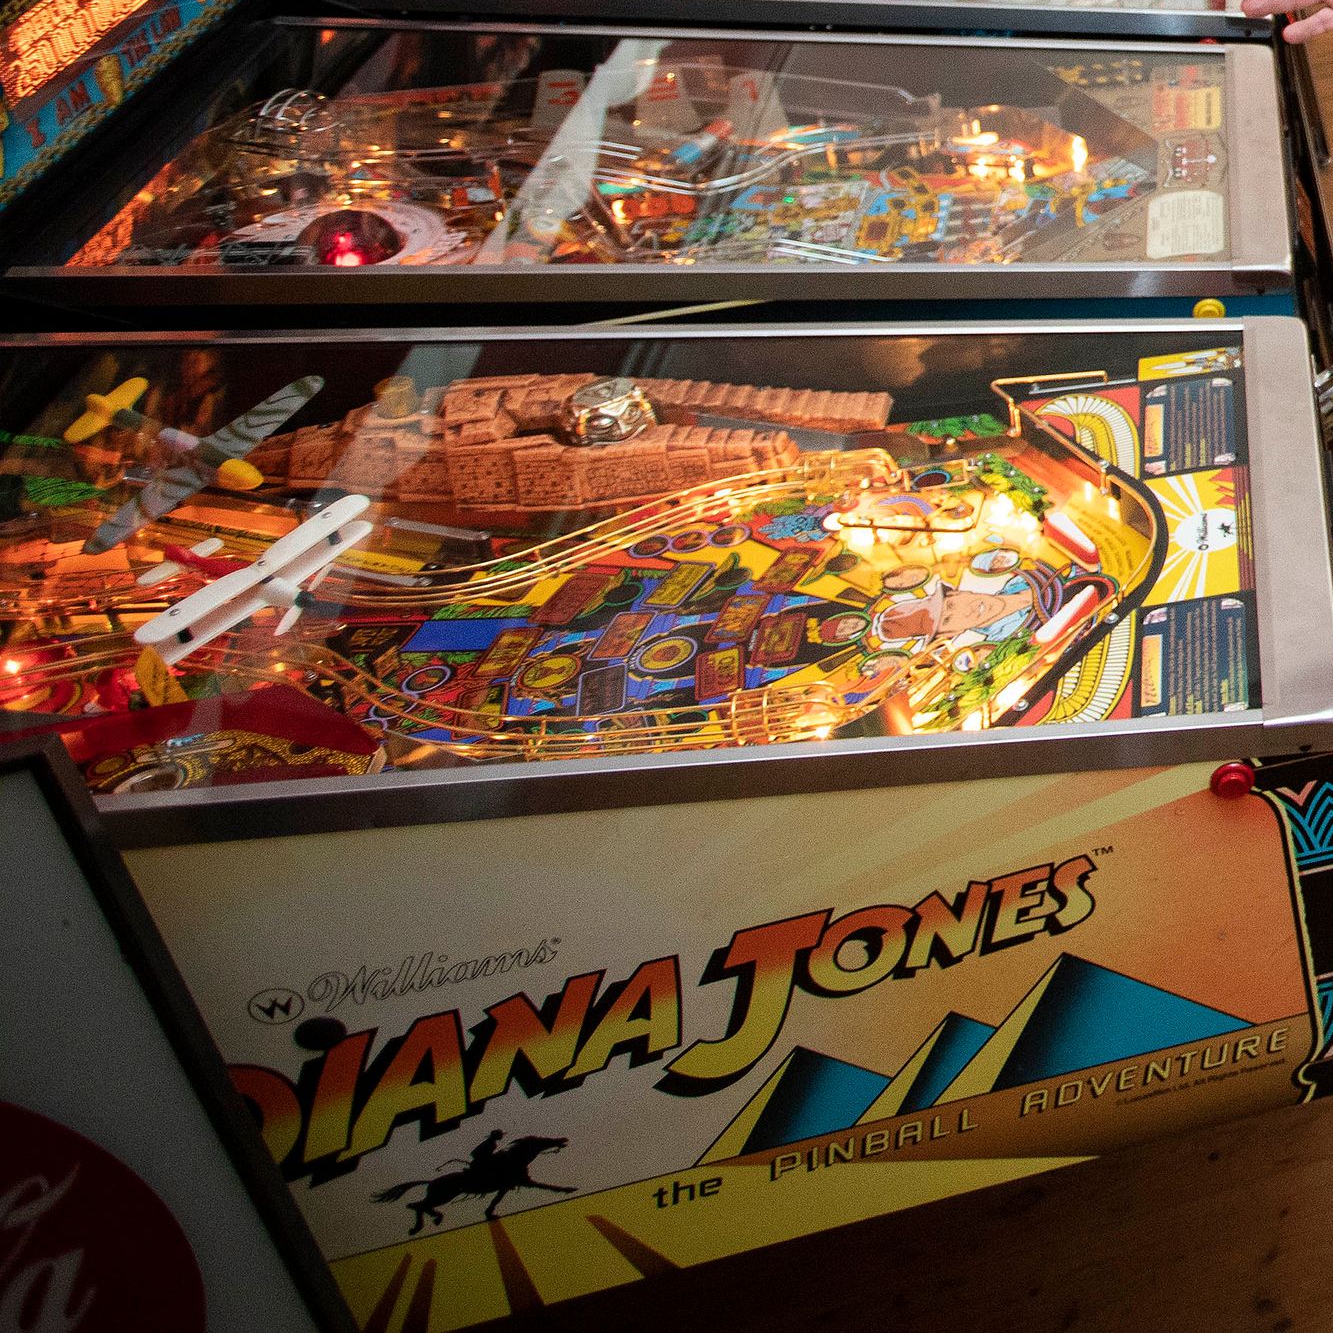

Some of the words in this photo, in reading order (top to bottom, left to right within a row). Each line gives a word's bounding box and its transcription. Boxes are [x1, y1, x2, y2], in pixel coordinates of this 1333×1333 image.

[306, 936, 553, 1005] Williams
[655, 854, 1098, 1097] JONES
[653, 1174, 722, 1207] the
[770, 1107, 979, 1180] PINBALL
[1020, 1026, 1293, 1116] ADVENTURE
